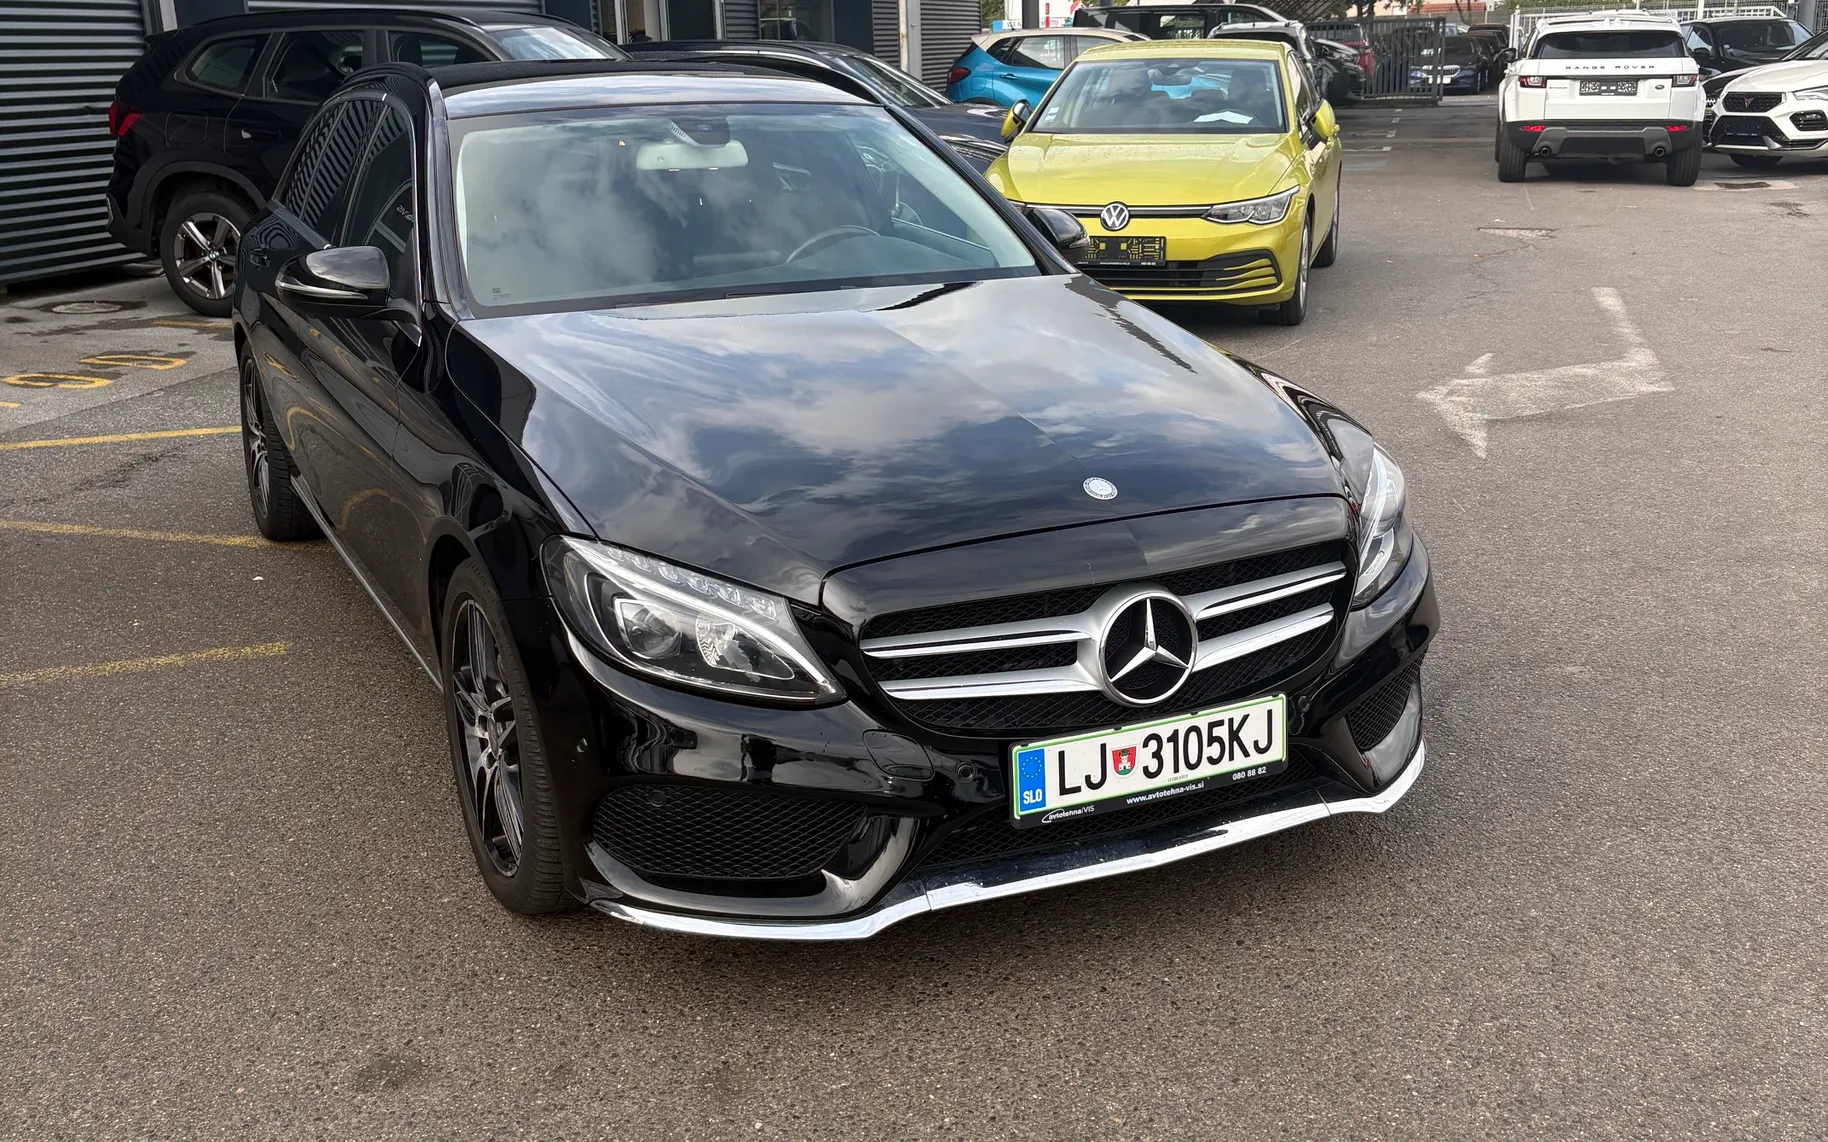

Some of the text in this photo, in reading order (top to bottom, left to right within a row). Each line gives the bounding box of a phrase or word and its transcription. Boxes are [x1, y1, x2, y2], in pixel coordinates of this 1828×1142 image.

[1057, 708, 1273, 797] LJ 3105KJ
[1232, 766, 1267, 781] 080 88 82
[1022, 787, 1044, 805] SLO
[1126, 780, 1205, 805] www.avtotehna-vis.si
